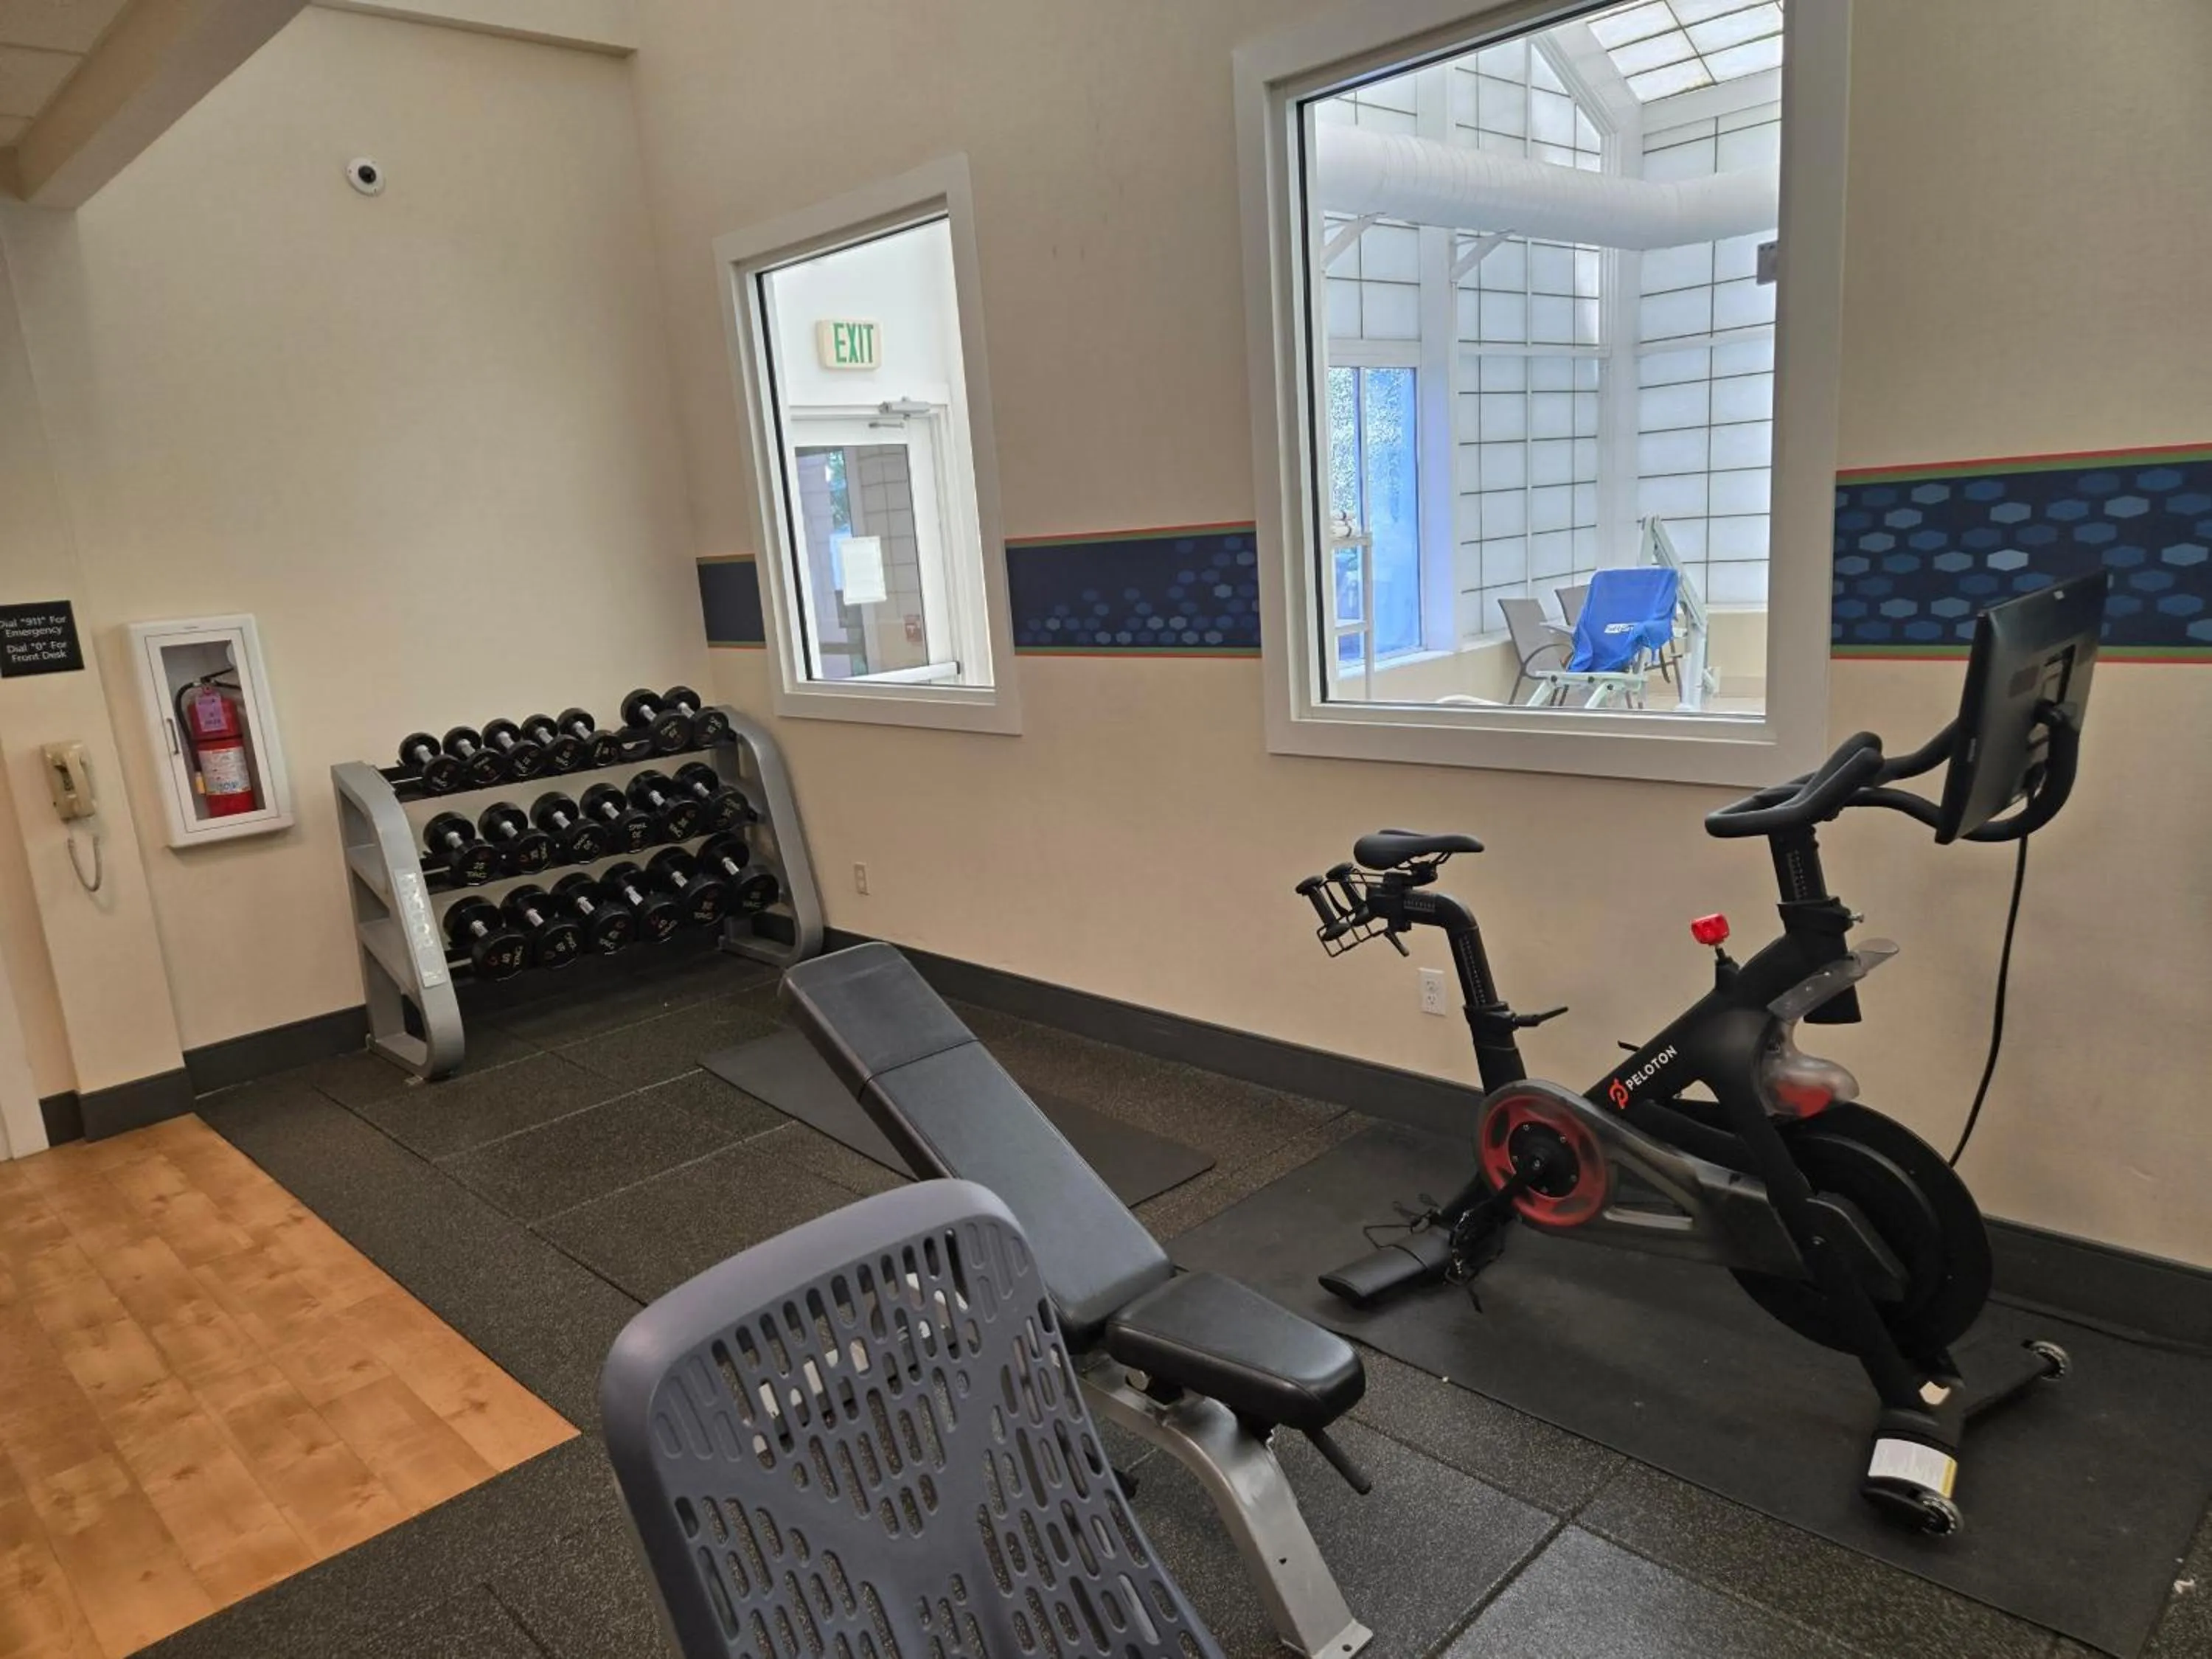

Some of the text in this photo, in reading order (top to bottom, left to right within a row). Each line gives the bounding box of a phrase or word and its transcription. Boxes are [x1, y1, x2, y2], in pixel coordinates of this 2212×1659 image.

[833, 323, 874, 363] EXIT
[49, 616, 66, 624] For
[5, 626, 63, 638] Emergency
[6, 643, 27, 654] Dial
[50, 641, 67, 650] For
[12, 649, 67, 663] Front Desk
[1625, 1045, 1678, 1092] PELOTON
